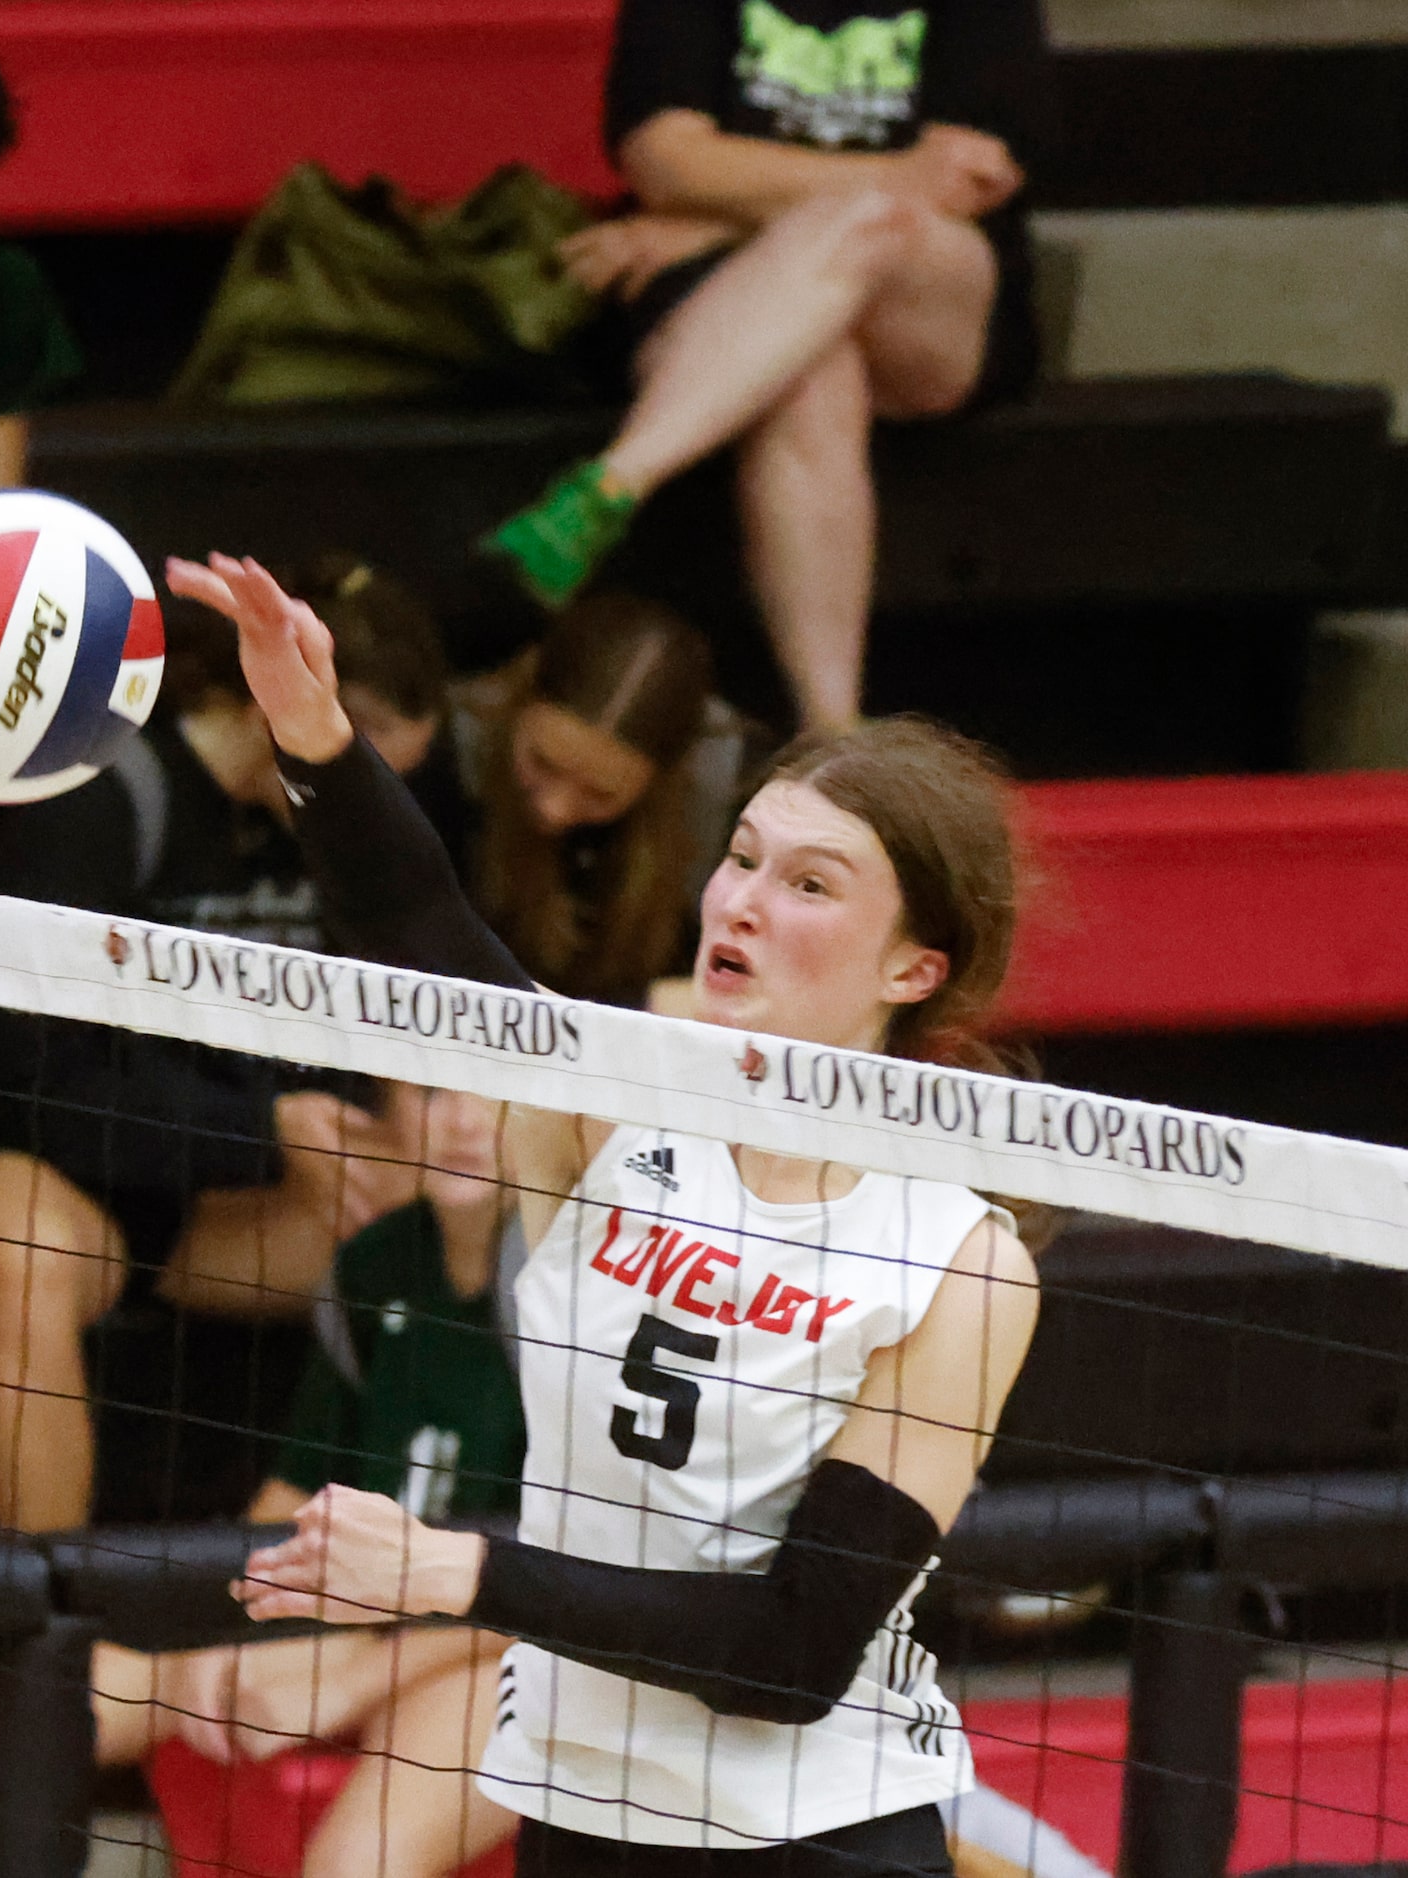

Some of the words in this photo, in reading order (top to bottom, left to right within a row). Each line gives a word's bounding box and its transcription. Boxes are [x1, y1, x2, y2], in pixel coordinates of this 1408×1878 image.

[142, 928, 348, 1018] LOVEJOY
[356, 968, 582, 1062] LEOPARDS
[624, 1157, 680, 1193] adidas
[782, 1046, 991, 1138] LOVEJOY
[1005, 1087, 1248, 1186] LEOPARDS
[590, 1207, 855, 1344] LOVEJOY
[609, 1313, 720, 1471] 5
